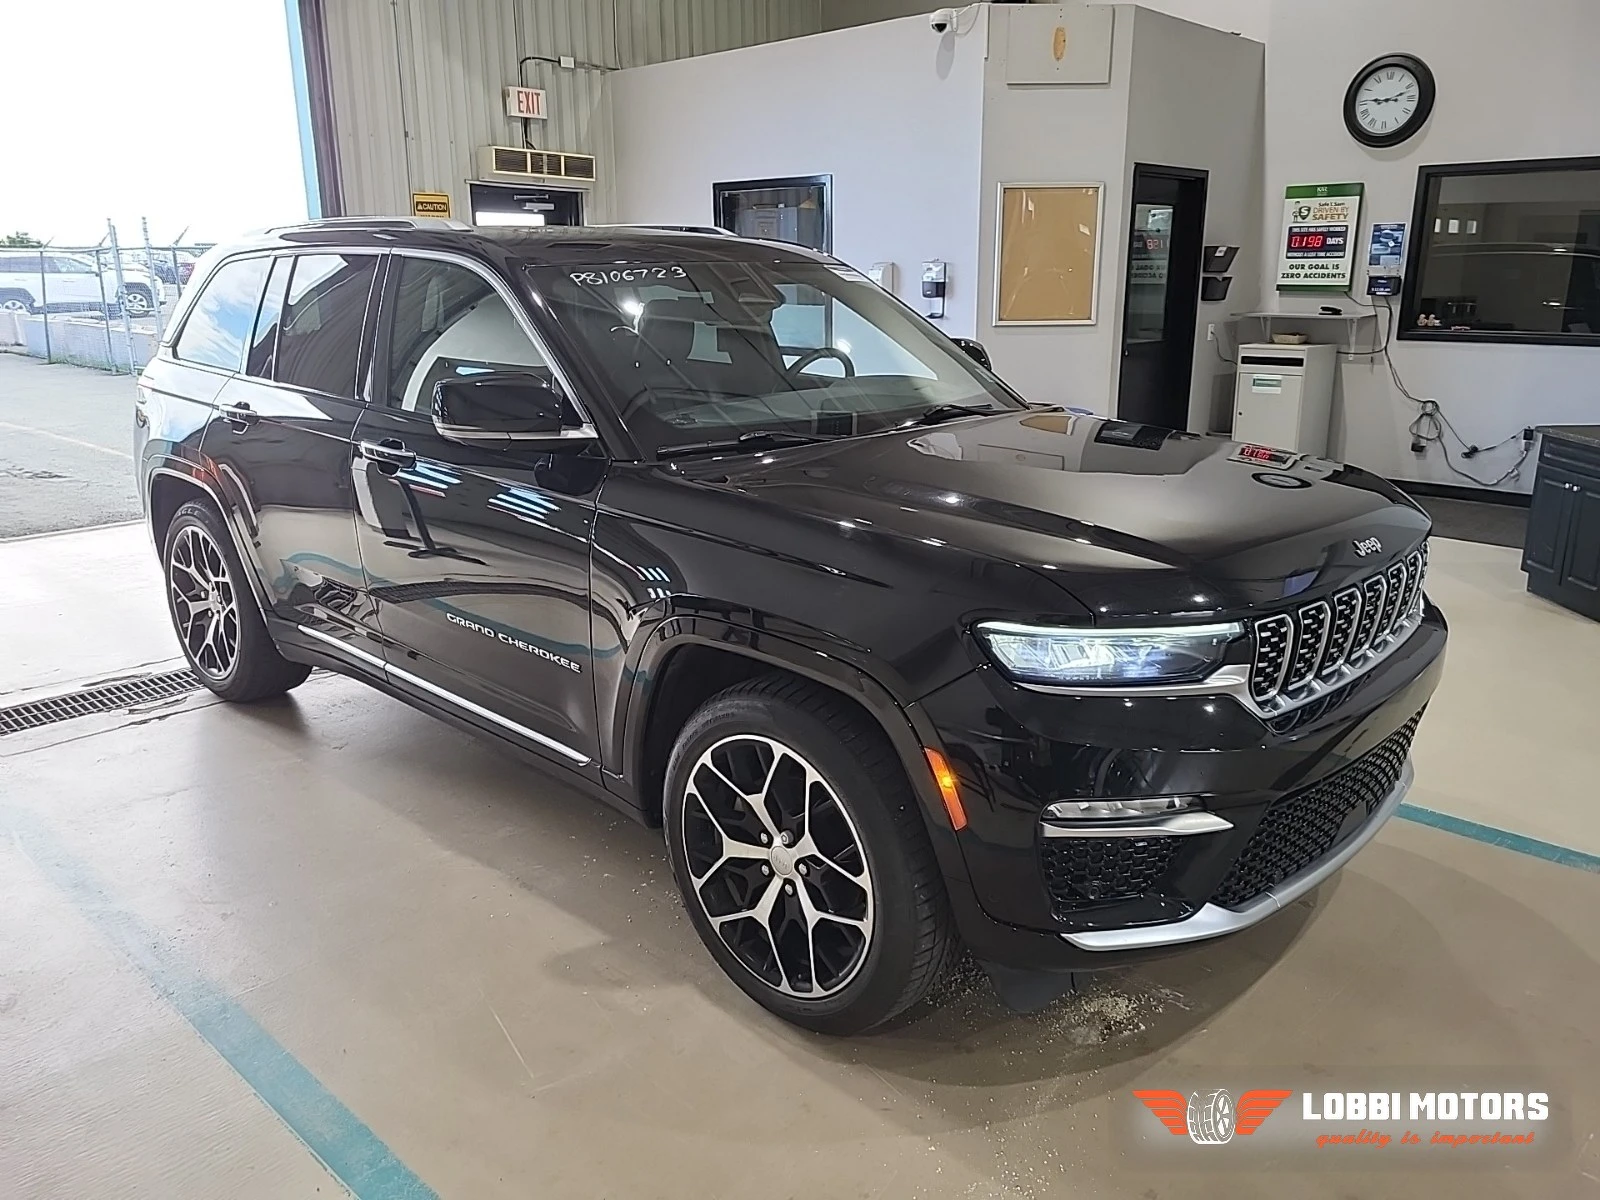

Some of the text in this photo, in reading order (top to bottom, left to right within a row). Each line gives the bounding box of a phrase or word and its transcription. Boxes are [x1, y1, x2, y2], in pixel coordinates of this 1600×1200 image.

[516, 90, 541, 116] EXIT
[422, 202, 447, 211] CAUTION
[1312, 206, 1340, 214] DRIVEN
[1312, 213, 1349, 221] SAFETY
[1291, 235, 1323, 248] 0198
[1326, 237, 1344, 245] DAYS
[1353, 537, 1382, 557] Jeep
[446, 612, 582, 674] GRAND CHEROKEE
